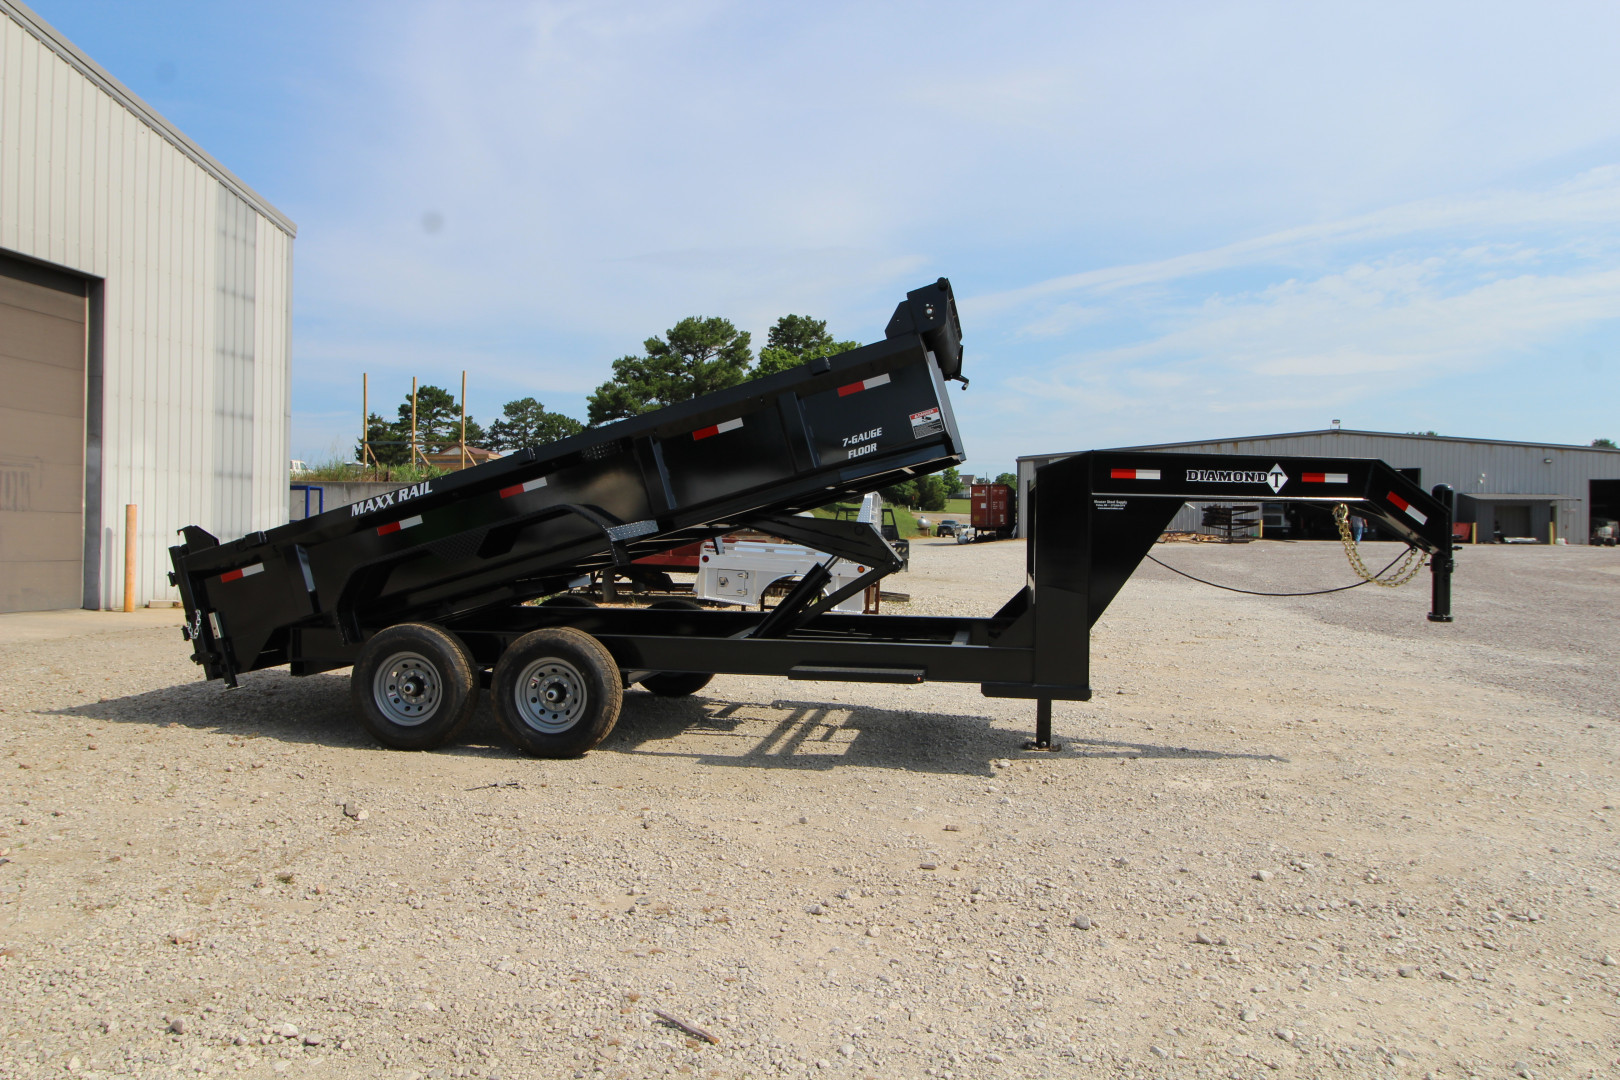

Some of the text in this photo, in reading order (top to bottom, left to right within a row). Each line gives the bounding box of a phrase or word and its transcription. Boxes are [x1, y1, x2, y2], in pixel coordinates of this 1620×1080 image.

[842, 427, 883, 447] 7-GAUGE
[848, 442, 878, 460] FLOOR
[1186, 469, 1267, 483] DIAMOND
[351, 481, 433, 517] MAXX RAIL
